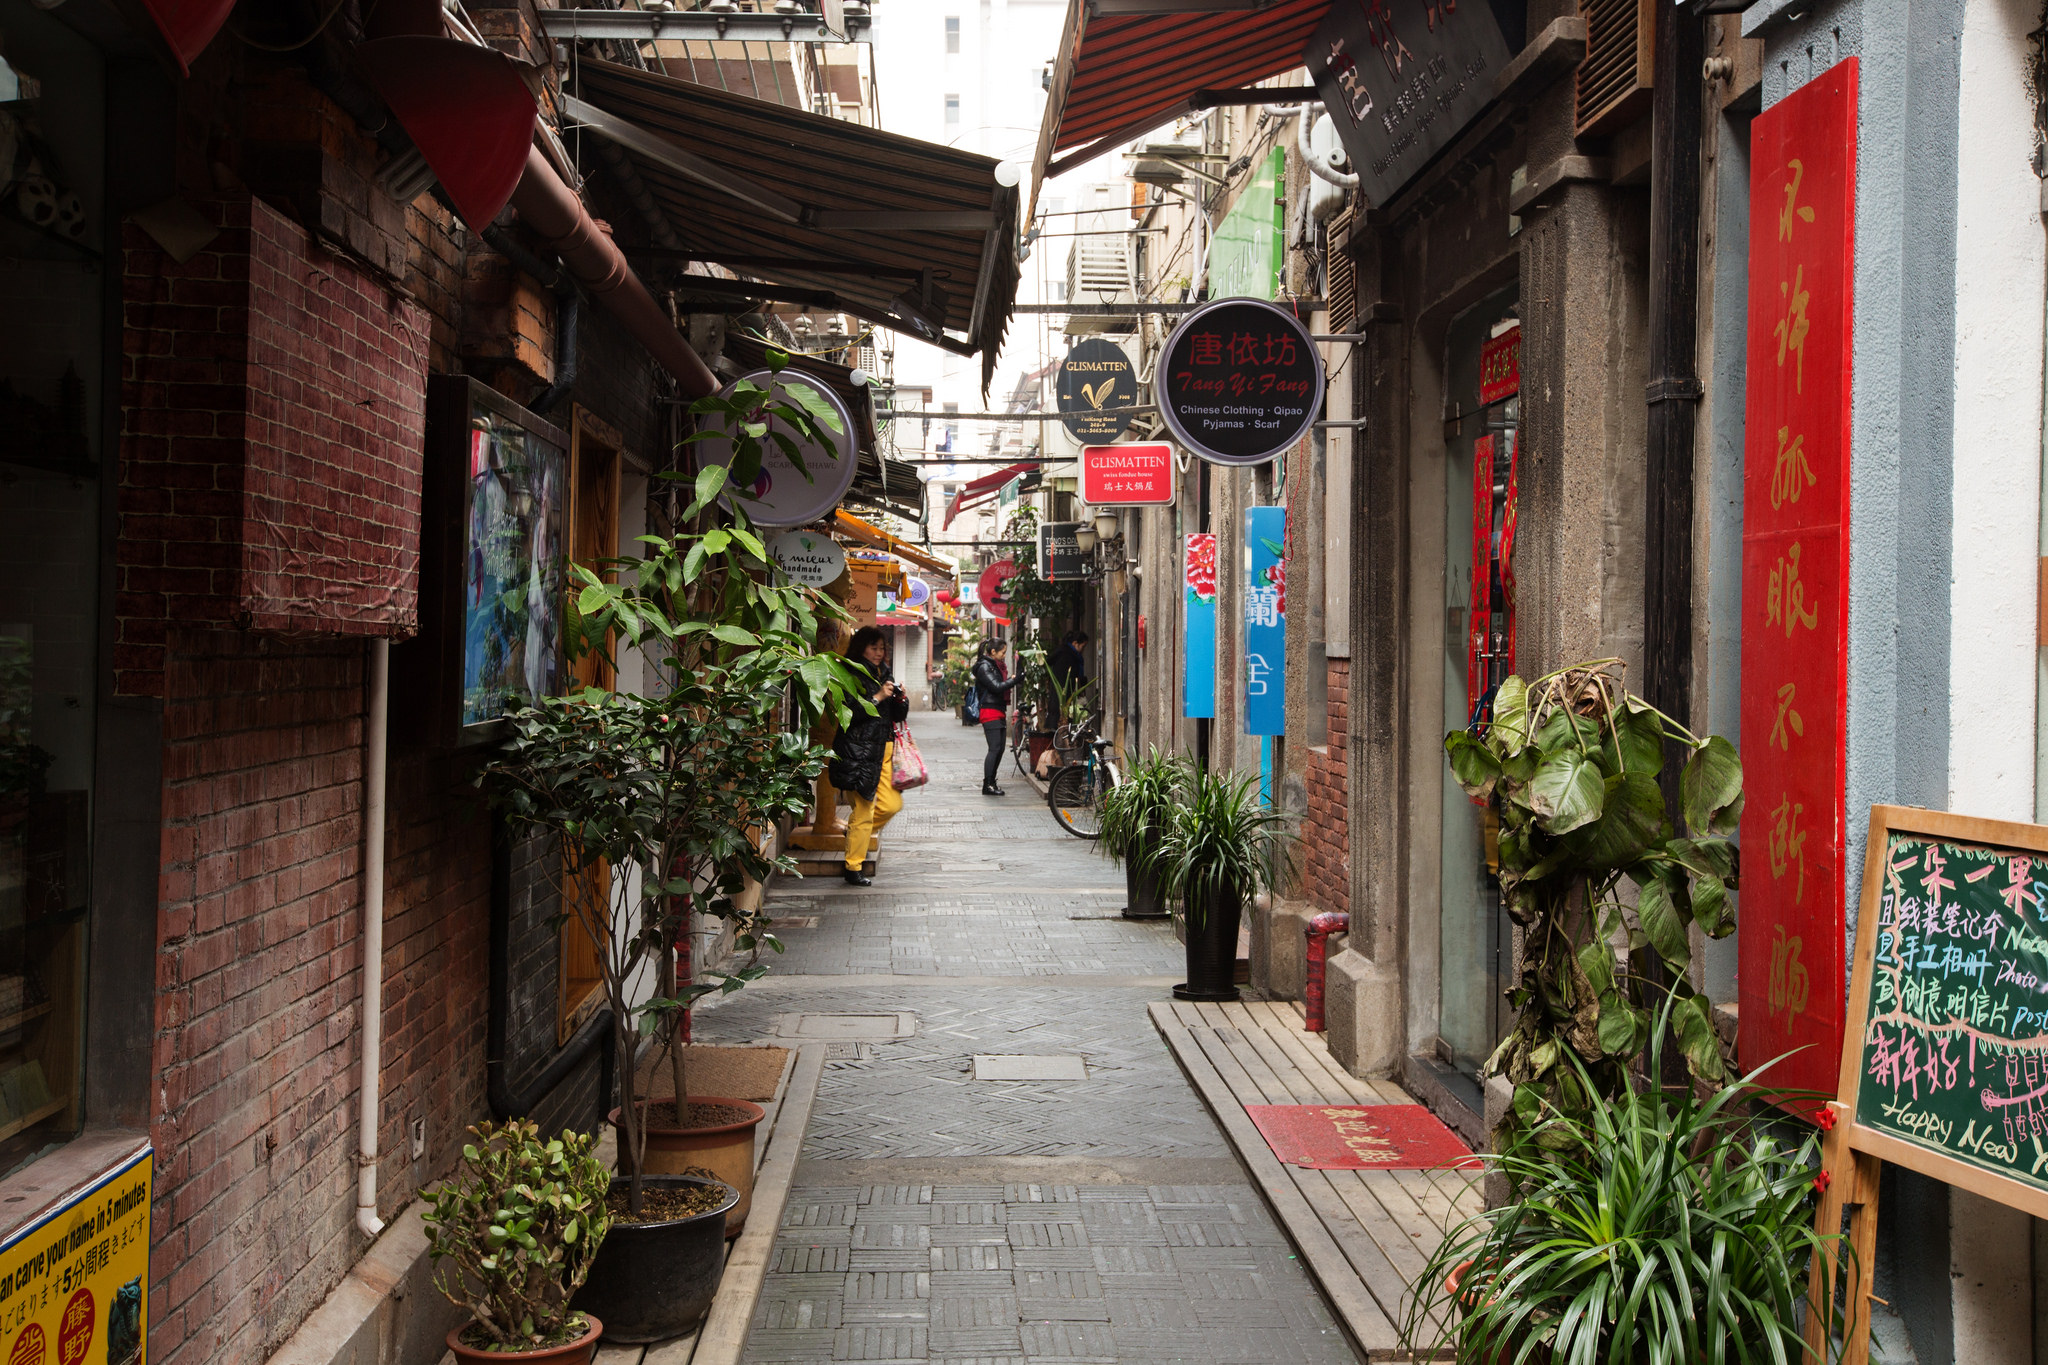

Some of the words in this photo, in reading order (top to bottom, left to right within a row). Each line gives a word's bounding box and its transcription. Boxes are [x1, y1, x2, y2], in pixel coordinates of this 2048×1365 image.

[1189, 332, 1297, 366] 唐依坊
[1066, 361, 1128, 372] GLISMATTEN
[1176, 371, 1225, 398] Tang
[1229, 373, 1256, 398] Yi
[1259, 373, 1309, 399] Fang
[1180, 405, 1220, 415] Chinese
[1222, 405, 1264, 417] Clothing
[1273, 406, 1303, 417] Qipao
[1203, 419, 1245, 430] Pyjamas
[1254, 419, 1281, 429] Scarf
[806, 462, 837, 470] SHAWL
[1091, 456, 1165, 468] GLISMATTEN
[790, 554, 834, 565] mieux
[783, 564, 822, 573] handmade
[1901, 974, 2010, 1034] 创意明信片
[1881, 1093, 1953, 1146] Happy
[1957, 1118, 2018, 1164] New
[16, 1251, 45, 1291] carve
[46, 1234, 69, 1278] your
[69, 1216, 95, 1254] name
[97, 1205, 105, 1234] in
[106, 1198, 113, 1227] 5
[114, 1181, 146, 1222] minutes
